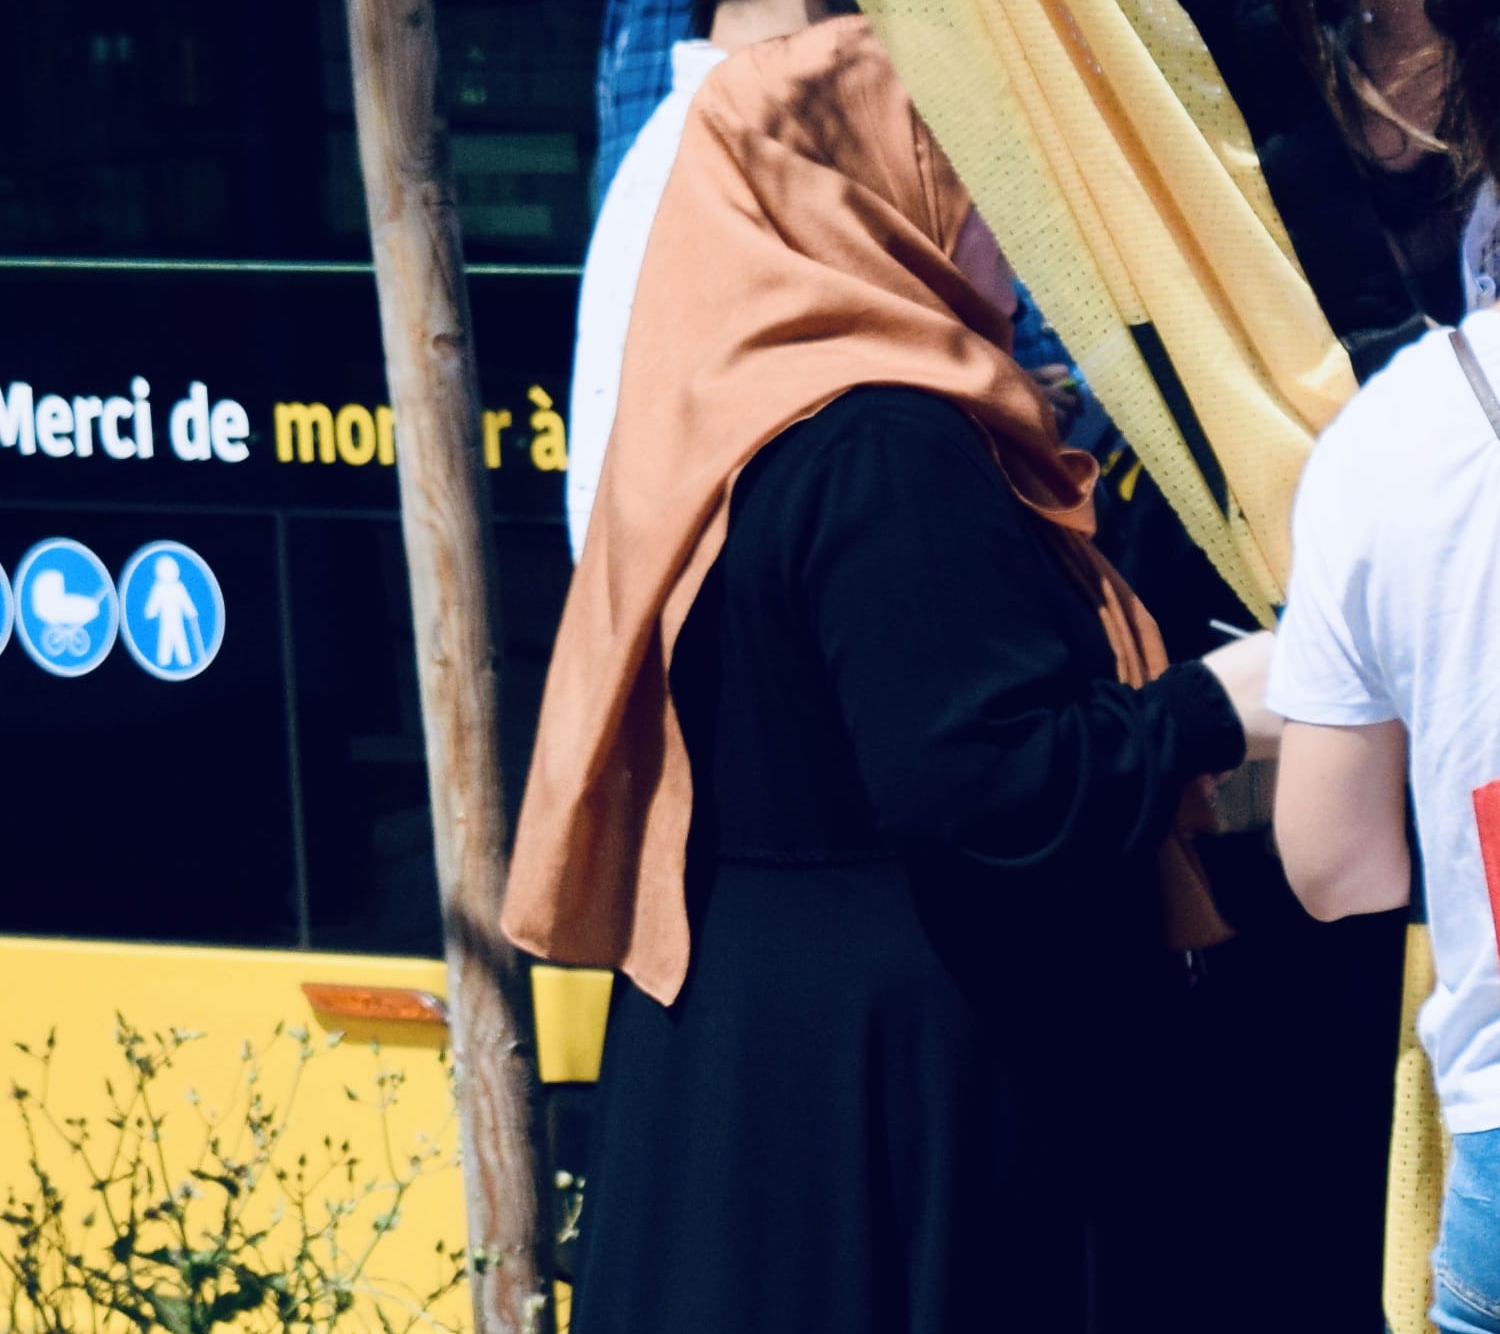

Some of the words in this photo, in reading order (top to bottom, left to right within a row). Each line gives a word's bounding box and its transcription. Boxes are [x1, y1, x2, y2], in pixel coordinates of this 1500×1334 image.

[0, 375, 154, 459] Merci
[169, 380, 251, 463] de
[528, 384, 568, 471] à
